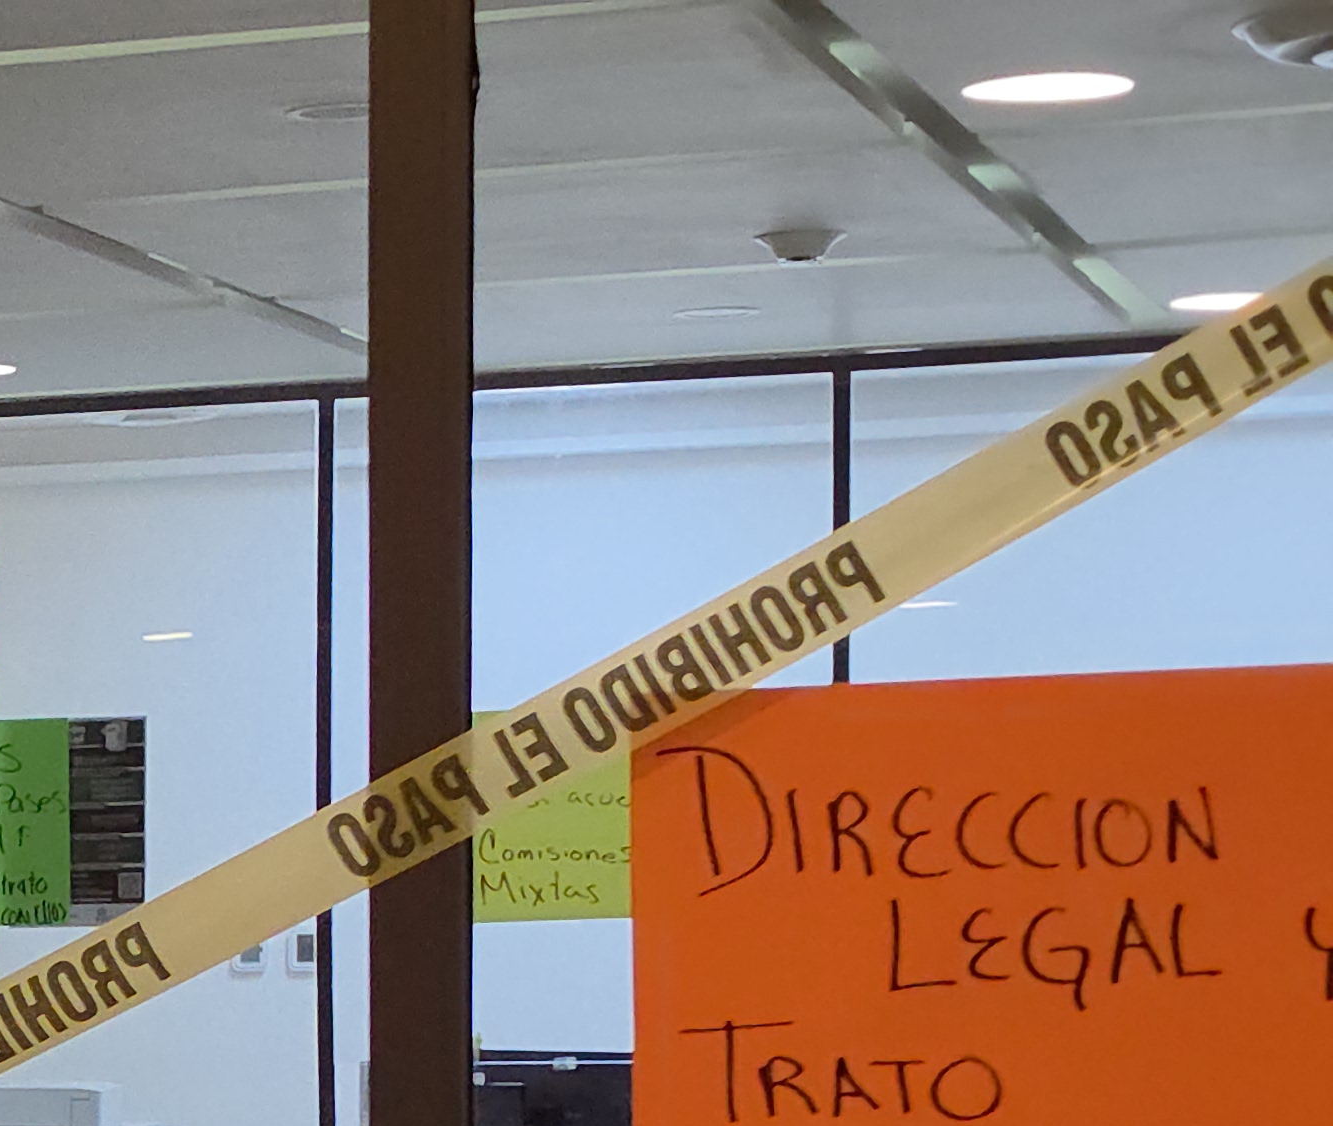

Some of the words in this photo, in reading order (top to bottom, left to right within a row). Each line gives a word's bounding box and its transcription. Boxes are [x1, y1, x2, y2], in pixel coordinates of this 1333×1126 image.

[655, 745, 1219, 897] DIRECCION
[480, 871, 599, 907] Mixtas
[889, 897, 1222, 1010] LEGAL
[678, 1019, 1002, 1122] TRATO
